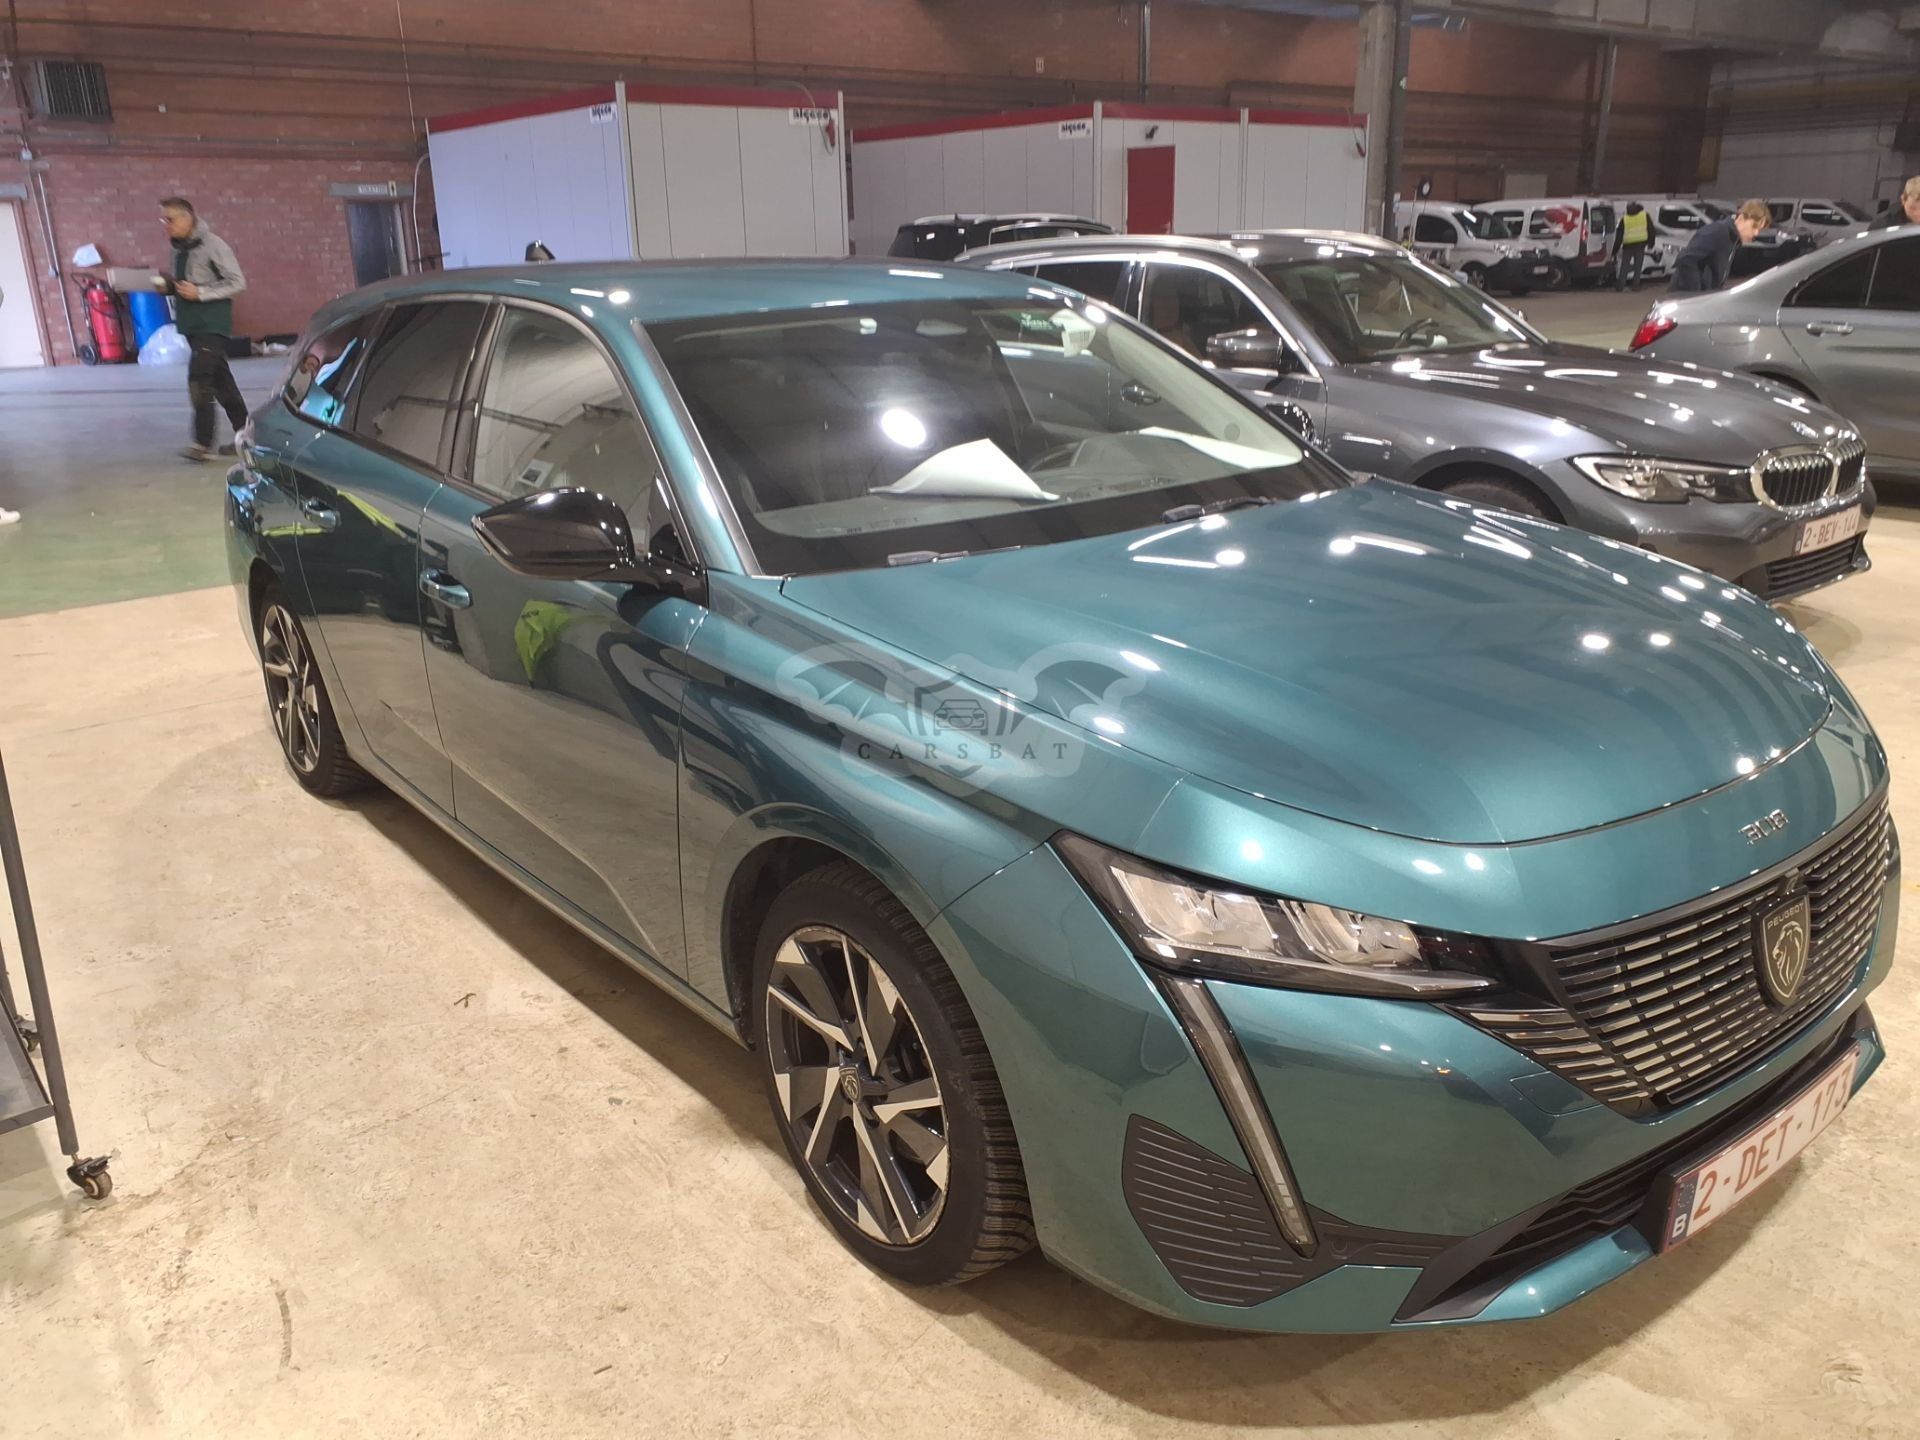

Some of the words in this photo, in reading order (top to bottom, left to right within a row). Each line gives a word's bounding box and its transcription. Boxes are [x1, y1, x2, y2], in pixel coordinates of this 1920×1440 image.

[1738, 809, 1789, 845] 308
[1767, 902, 1804, 930] PEUGEOT
[1671, 1213, 1688, 1238] B
